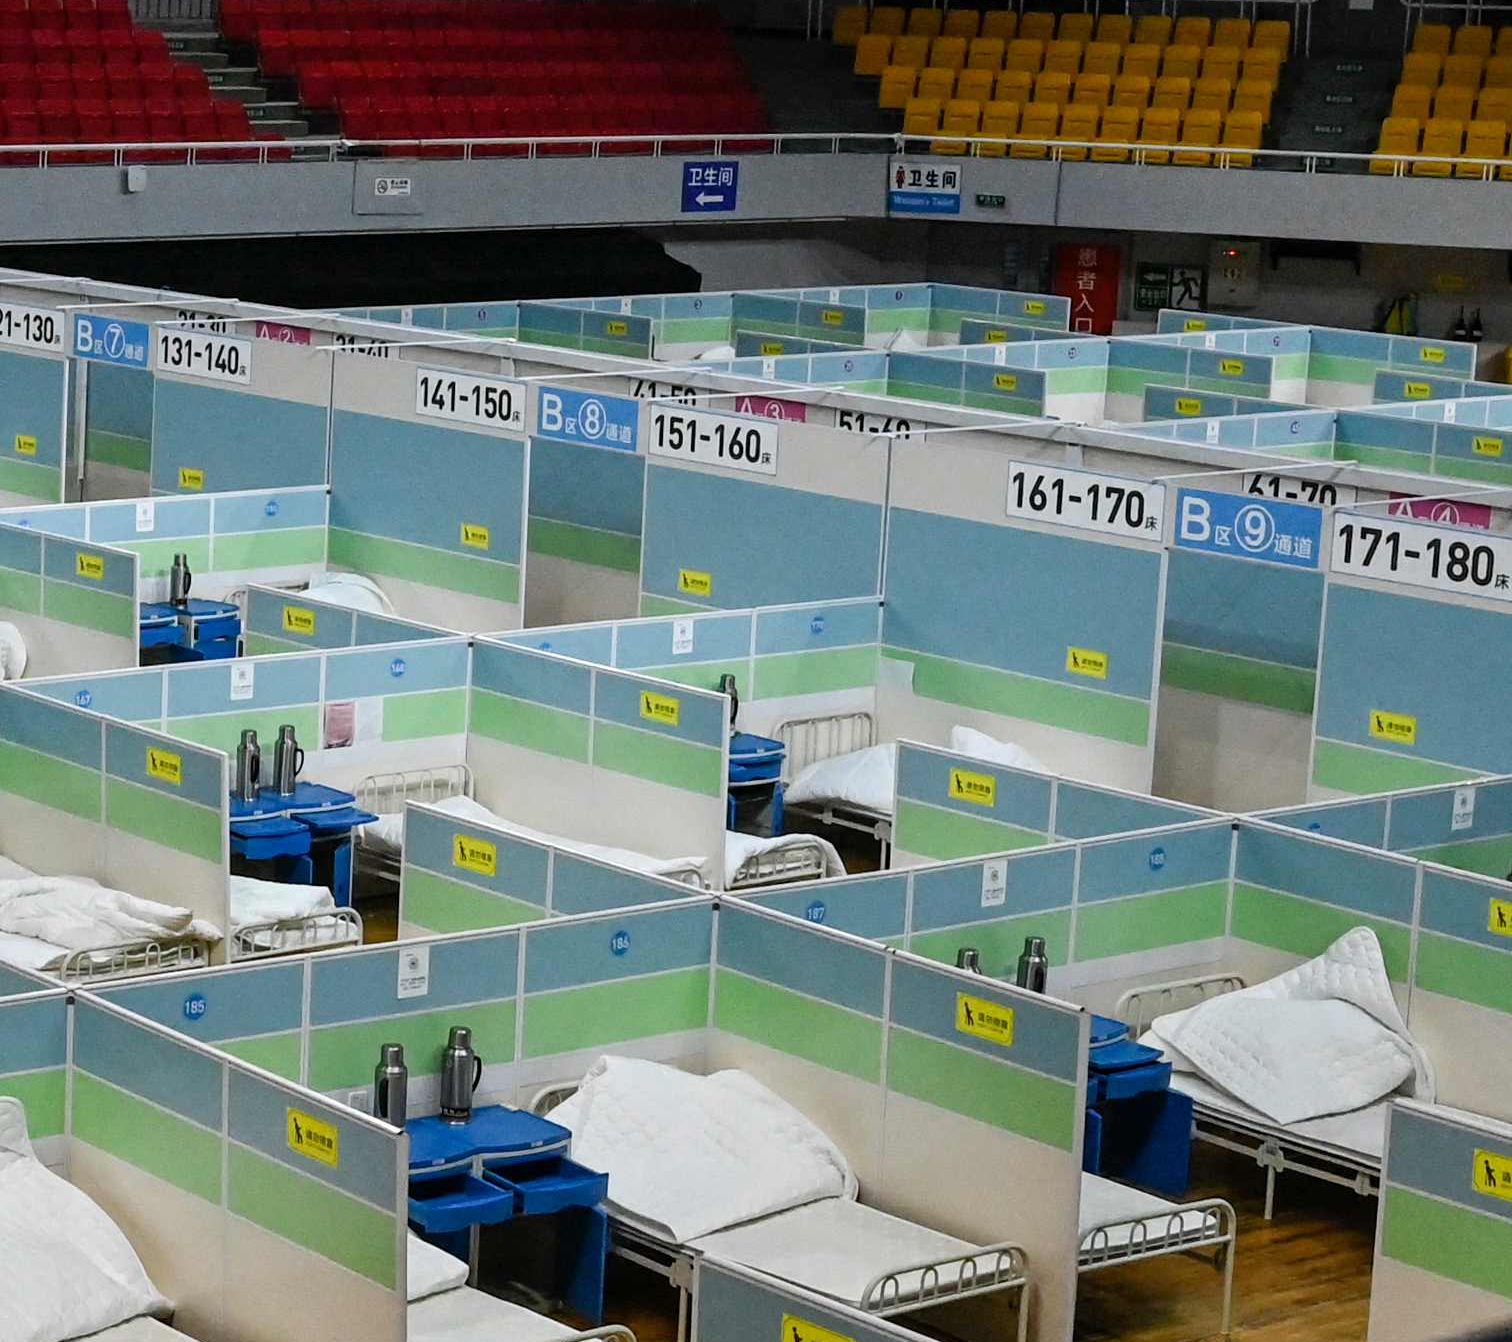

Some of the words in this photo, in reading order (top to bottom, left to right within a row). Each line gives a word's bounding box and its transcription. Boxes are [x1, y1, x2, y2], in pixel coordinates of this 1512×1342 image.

[687, 167, 733, 189] 卫生间
[908, 170, 956, 189] 卫生间
[1013, 472, 1158, 531] 161-170床
[1339, 524, 1511, 590] 171-180床
[808, 907, 825, 920] 187
[185, 999, 205, 1014] 185
